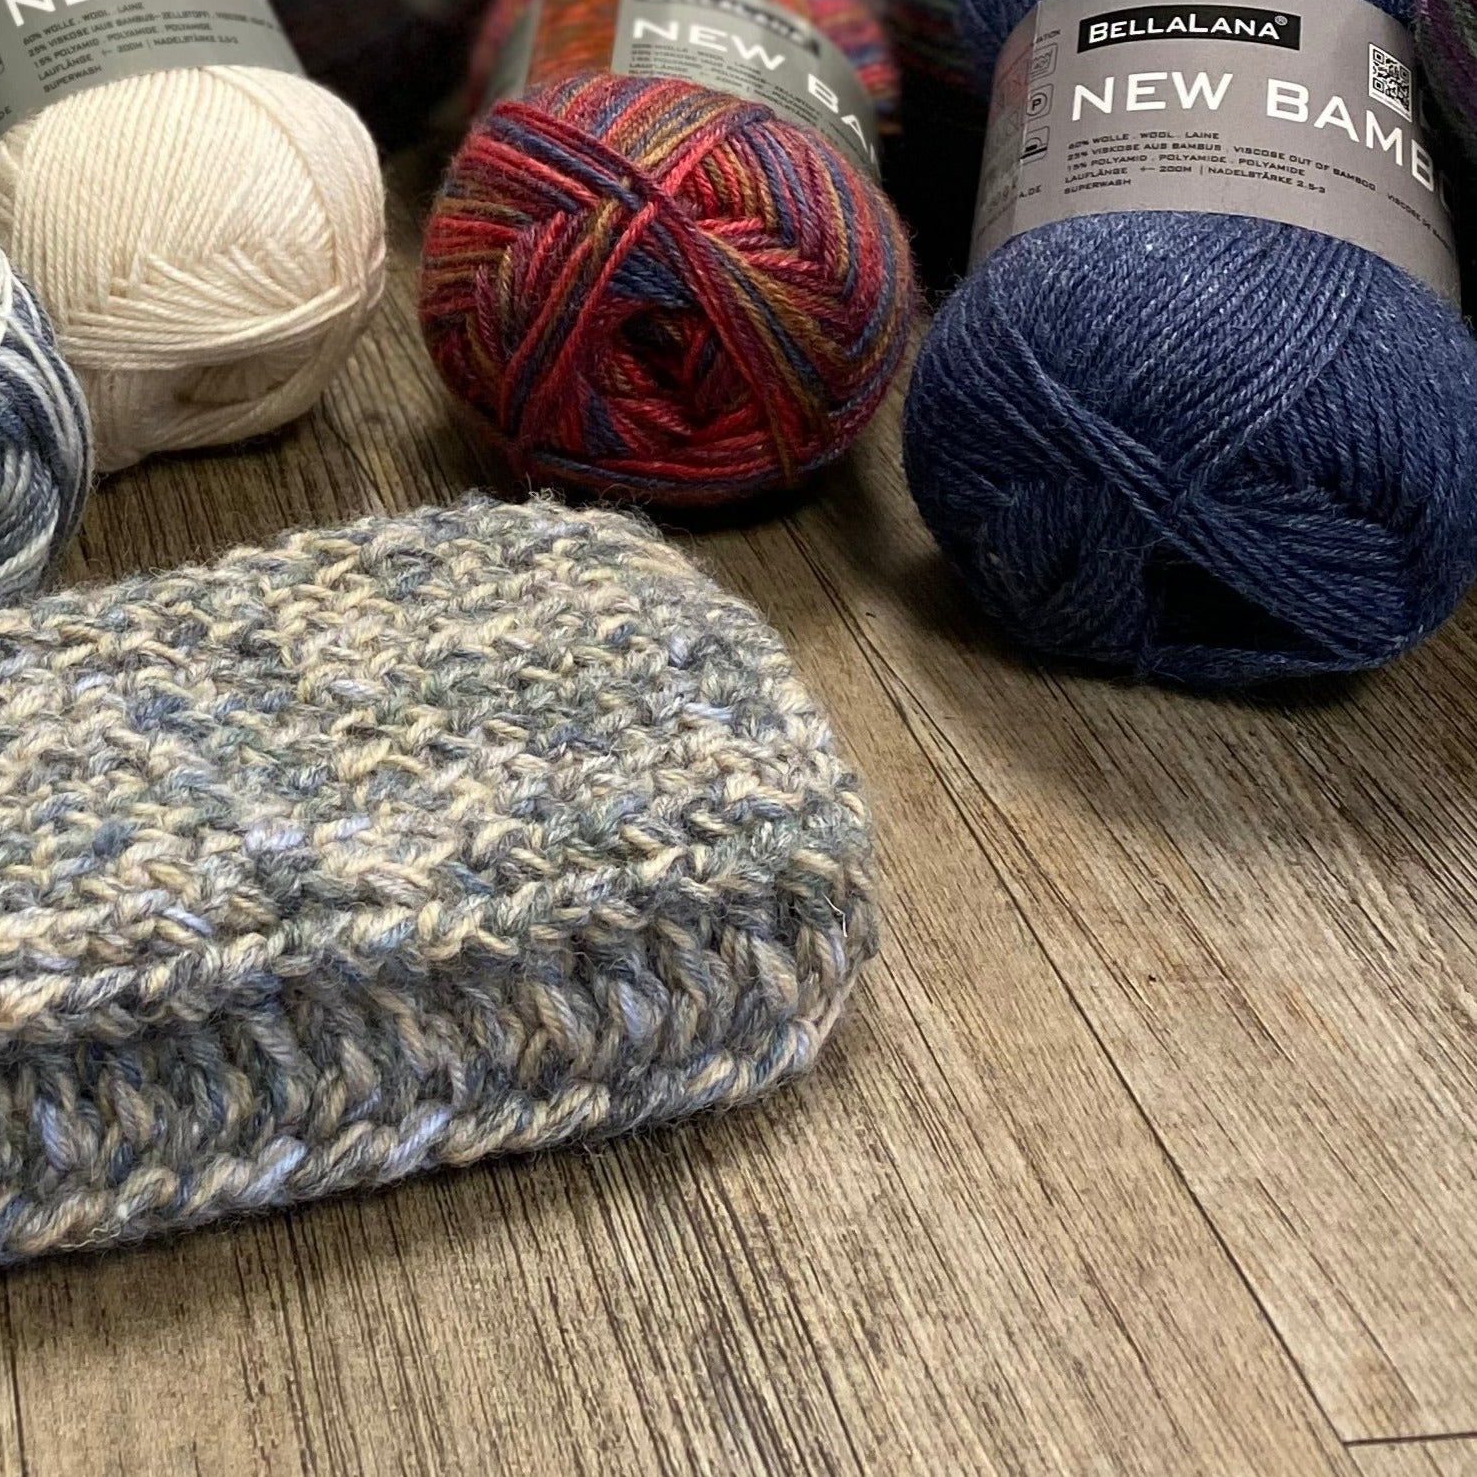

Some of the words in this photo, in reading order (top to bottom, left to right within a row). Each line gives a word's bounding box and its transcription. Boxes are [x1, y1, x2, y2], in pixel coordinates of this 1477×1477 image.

[43, 18, 76, 35] WOLLE
[633, 18, 785, 70] NEW
[43, 65, 103, 94] SUPERWASH
[1072, 71, 1233, 121] NEW
[1092, 133, 1130, 144] WOLLE
[1139, 131, 1174, 139] WOOL
[1184, 131, 1220, 140] LAINE
[1090, 154, 1148, 166] POLYAMID
[1158, 154, 1227, 164] POLYAMIDE
[1238, 157, 1306, 176] POLYAMIDE
[1091, 143, 1140, 155] VISKOSE
[1143, 142, 1168, 150] AUS
[1171, 142, 1222, 152] BAMBUS
[1233, 145, 1286, 160] VISCOSE
[1289, 155, 1313, 166] OUT
[1333, 168, 1376, 191] BAMBOO
[1063, 178, 1132, 195] SUPERWASH
